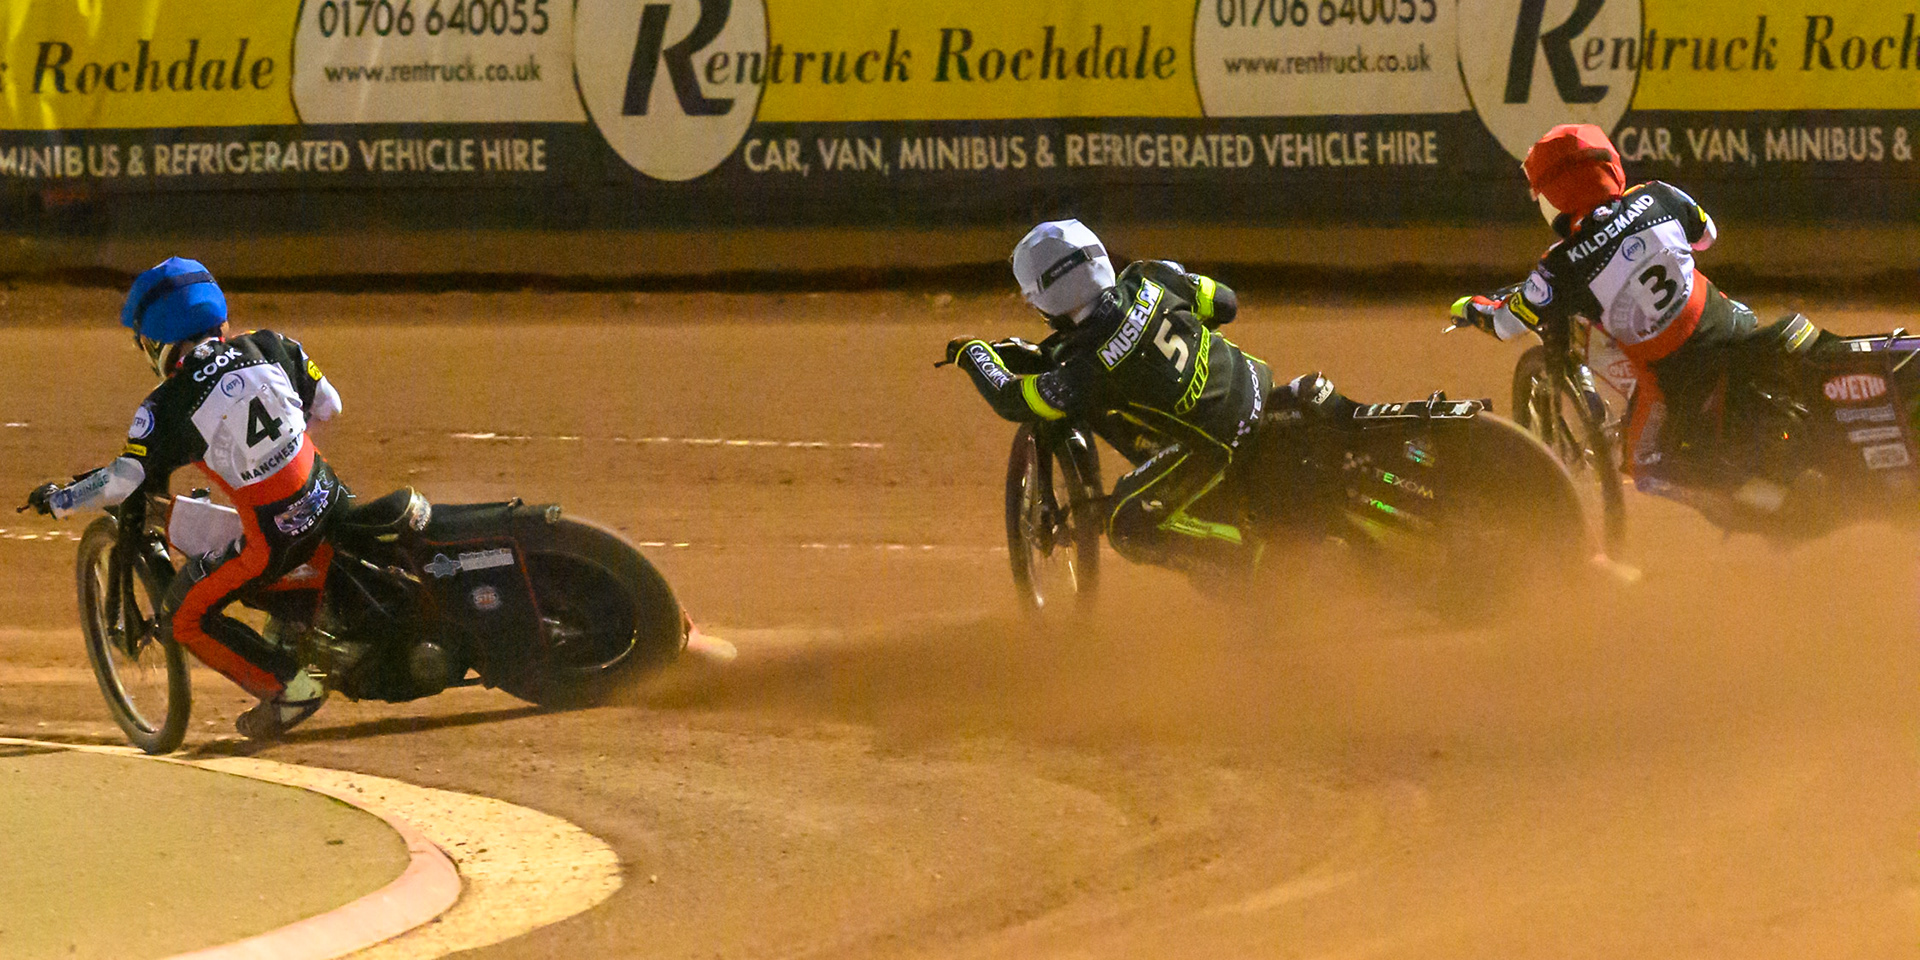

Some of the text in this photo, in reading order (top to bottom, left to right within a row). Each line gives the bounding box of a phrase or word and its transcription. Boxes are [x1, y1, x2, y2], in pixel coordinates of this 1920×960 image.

[319, 0, 550, 37] 01706 640055
[1216, 0, 1438, 27] 01706 640055
[31, 38, 274, 95] Rochdale
[324, 54, 542, 83] www.rentruck.co.uk
[621, 0, 1177, 117] Rentruck Rochdale
[1223, 43, 1433, 74] www.rentruck.co.uk
[1503, 0, 1778, 104] Rentruck
[0, 138, 547, 178] MINIBUS & REFRIGERATED VEHICLE HIRE
[744, 130, 1439, 177] CAR, VAN, MINIBUS & REFRIGERATED VEHICLE HIRE
[1618, 125, 1913, 168] CAR, VAN, MINIBUS &
[1567, 194, 1655, 263] KILDEMAND
[1638, 264, 1678, 311] 3
[193, 346, 243, 382] COOK
[1153, 317, 1189, 374] 5
[1247, 359, 1263, 420] TEXOM
[246, 395, 283, 448] 4
[1376, 468, 1434, 499] TEXOM
